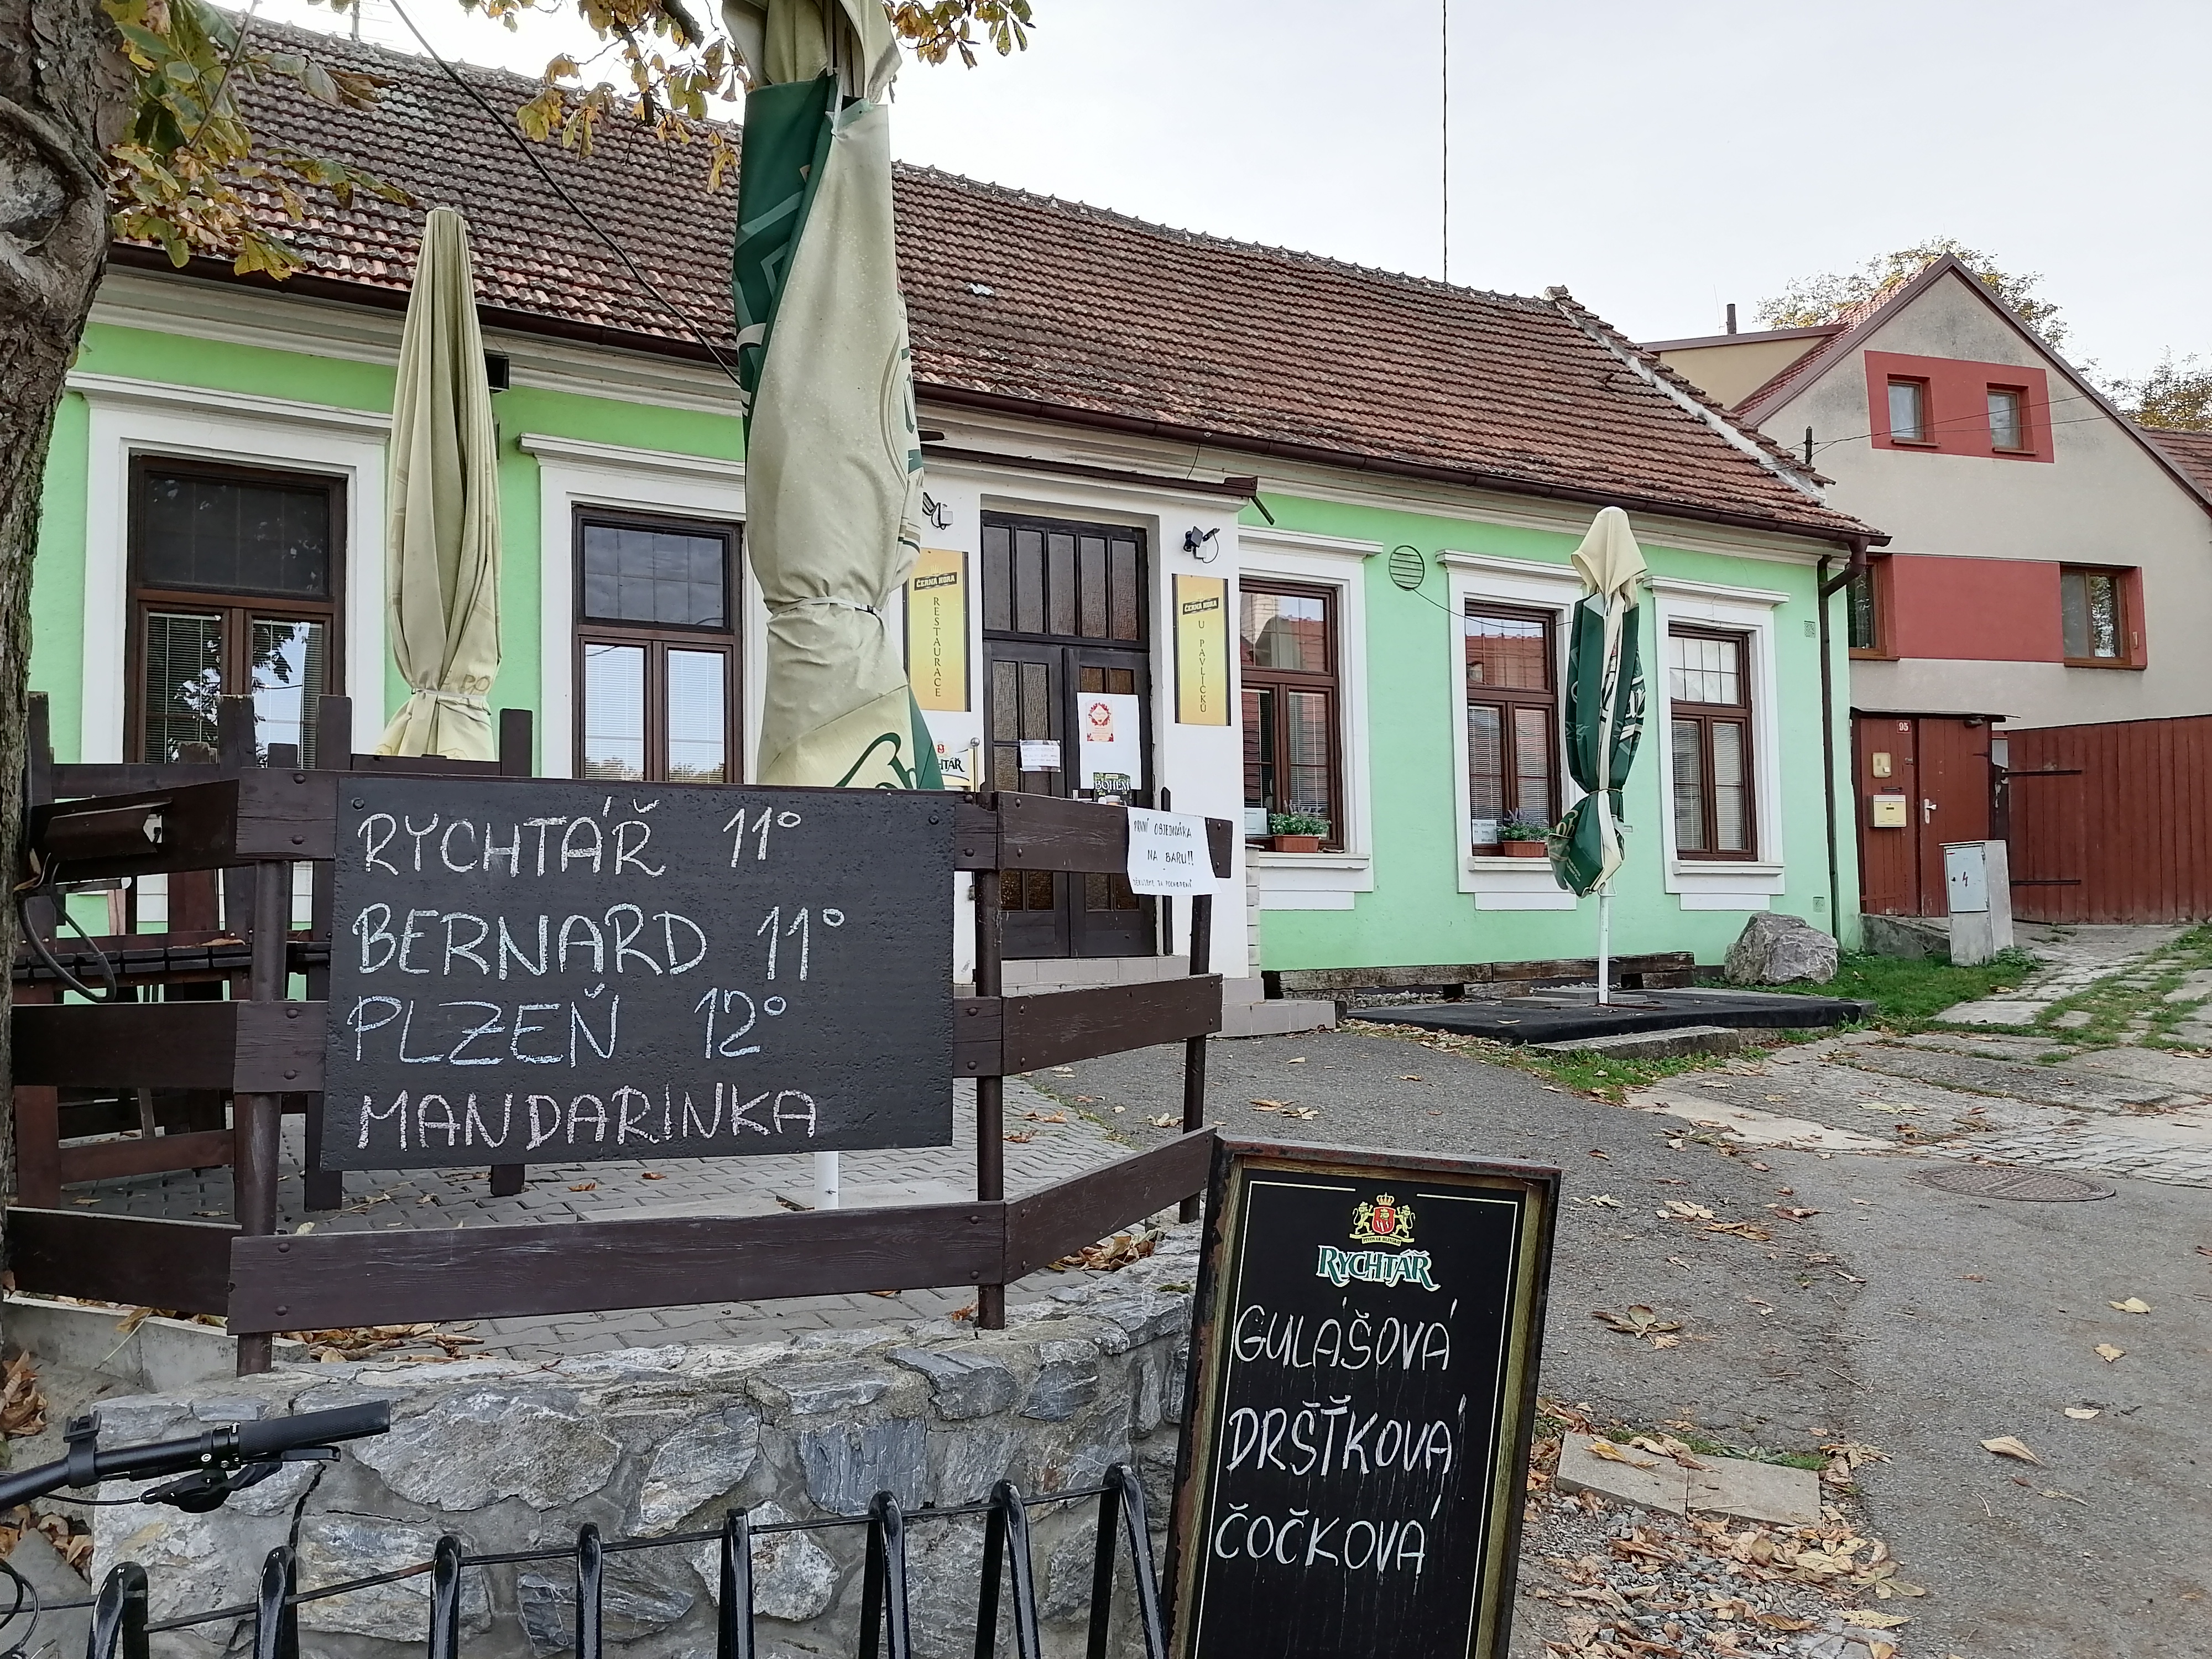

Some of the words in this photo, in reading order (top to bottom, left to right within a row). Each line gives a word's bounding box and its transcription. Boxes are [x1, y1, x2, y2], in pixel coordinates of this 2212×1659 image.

[938, 575, 955, 585] HORA
[933, 597, 941, 697] RESTAURACE
[1198, 620, 1204, 629] U
[1899, 722, 1908, 731] 95
[938, 757, 966, 773] HTÁŘ
[357, 796, 666, 877] RYCHTÁŘ
[1134, 818, 1149, 833] PRVNÍ
[1154, 822, 1192, 838] OBJEDNÁVKA
[1147, 849, 1158, 862] NA
[1165, 851, 1194, 866] BARU!!
[352, 902, 708, 980] BERNARD
[347, 982, 620, 1068] PLZEŇ
[356, 1082, 816, 1151] MANDARINKA
[1316, 1245, 1441, 1292] RYCHTÁŘ
[1234, 1296, 1458, 1371] GULÁŠOVÁ
[1225, 1394, 1467, 1477] DRŠŤKOVÁ
[1215, 1494, 1442, 1575] ČOČKOVÁ
